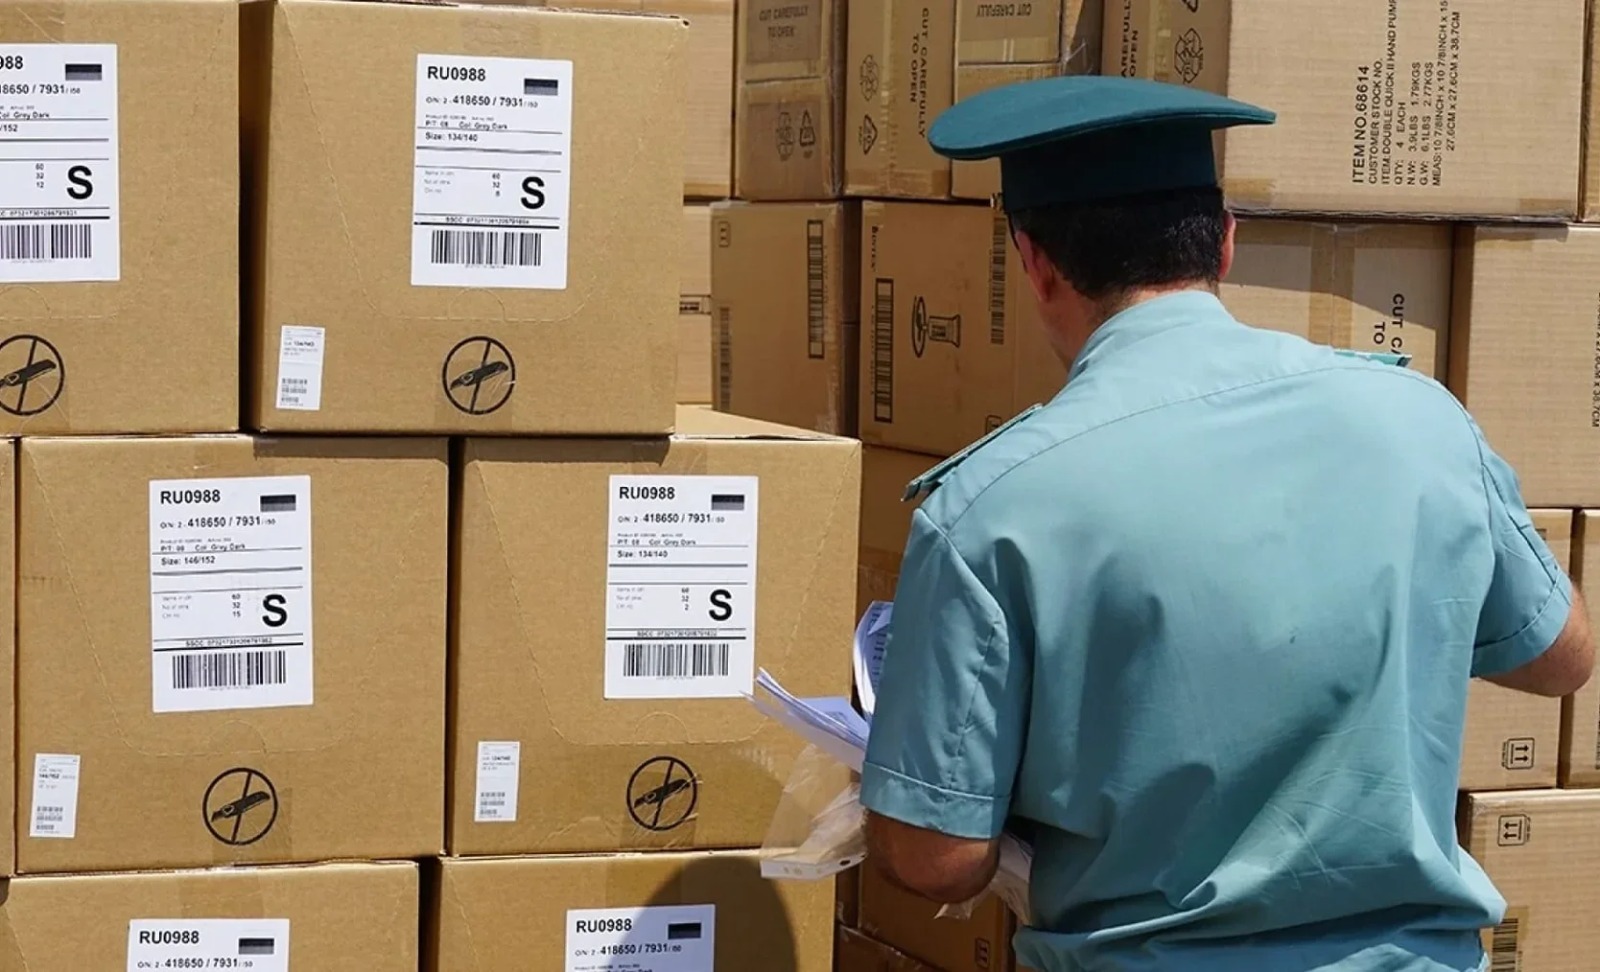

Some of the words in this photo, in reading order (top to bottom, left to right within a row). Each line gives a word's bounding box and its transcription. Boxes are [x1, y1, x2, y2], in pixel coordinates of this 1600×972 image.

[912, 33, 919, 53] TO
[1129, 30, 1138, 77] OPEN
[1387, 31, 1396, 61] HAND
[427, 66, 486, 81] RU0988
[1437, 70, 1445, 81] 10
[39, 84, 64, 94] 7931
[453, 95, 490, 105] 418650
[500, 96, 523, 107] 7931
[919, 47, 927, 138] CAREFULLY
[1372, 81, 1382, 118] STOCK
[1385, 72, 1394, 107] QUICK
[1354, 66, 1369, 140] NO.68614
[1396, 102, 1406, 132] EACH
[1409, 116, 1418, 152] 3.9LBS
[1352, 145, 1365, 183] ITEM
[1369, 122, 1379, 184] CUSTOMER
[67, 165, 93, 200] S
[1395, 160, 1404, 185] QTY:
[521, 176, 545, 209] S
[1392, 294, 1405, 328] CUT
[1373, 322, 1385, 344] TO
[161, 490, 221, 504] RU0988
[619, 486, 675, 499] RU0988
[188, 517, 226, 527] 418650
[236, 516, 260, 526] 7931
[643, 513, 679, 523] 418650
[688, 513, 711, 523] 7931
[262, 594, 287, 627] S
[709, 589, 732, 621] S
[139, 930, 200, 944] RU0988
[576, 918, 632, 933] RU0988
[600, 945, 636, 954] 418650
[645, 943, 668, 953] 7931
[165, 958, 203, 968] 418650
[213, 958, 238, 968] 7931
